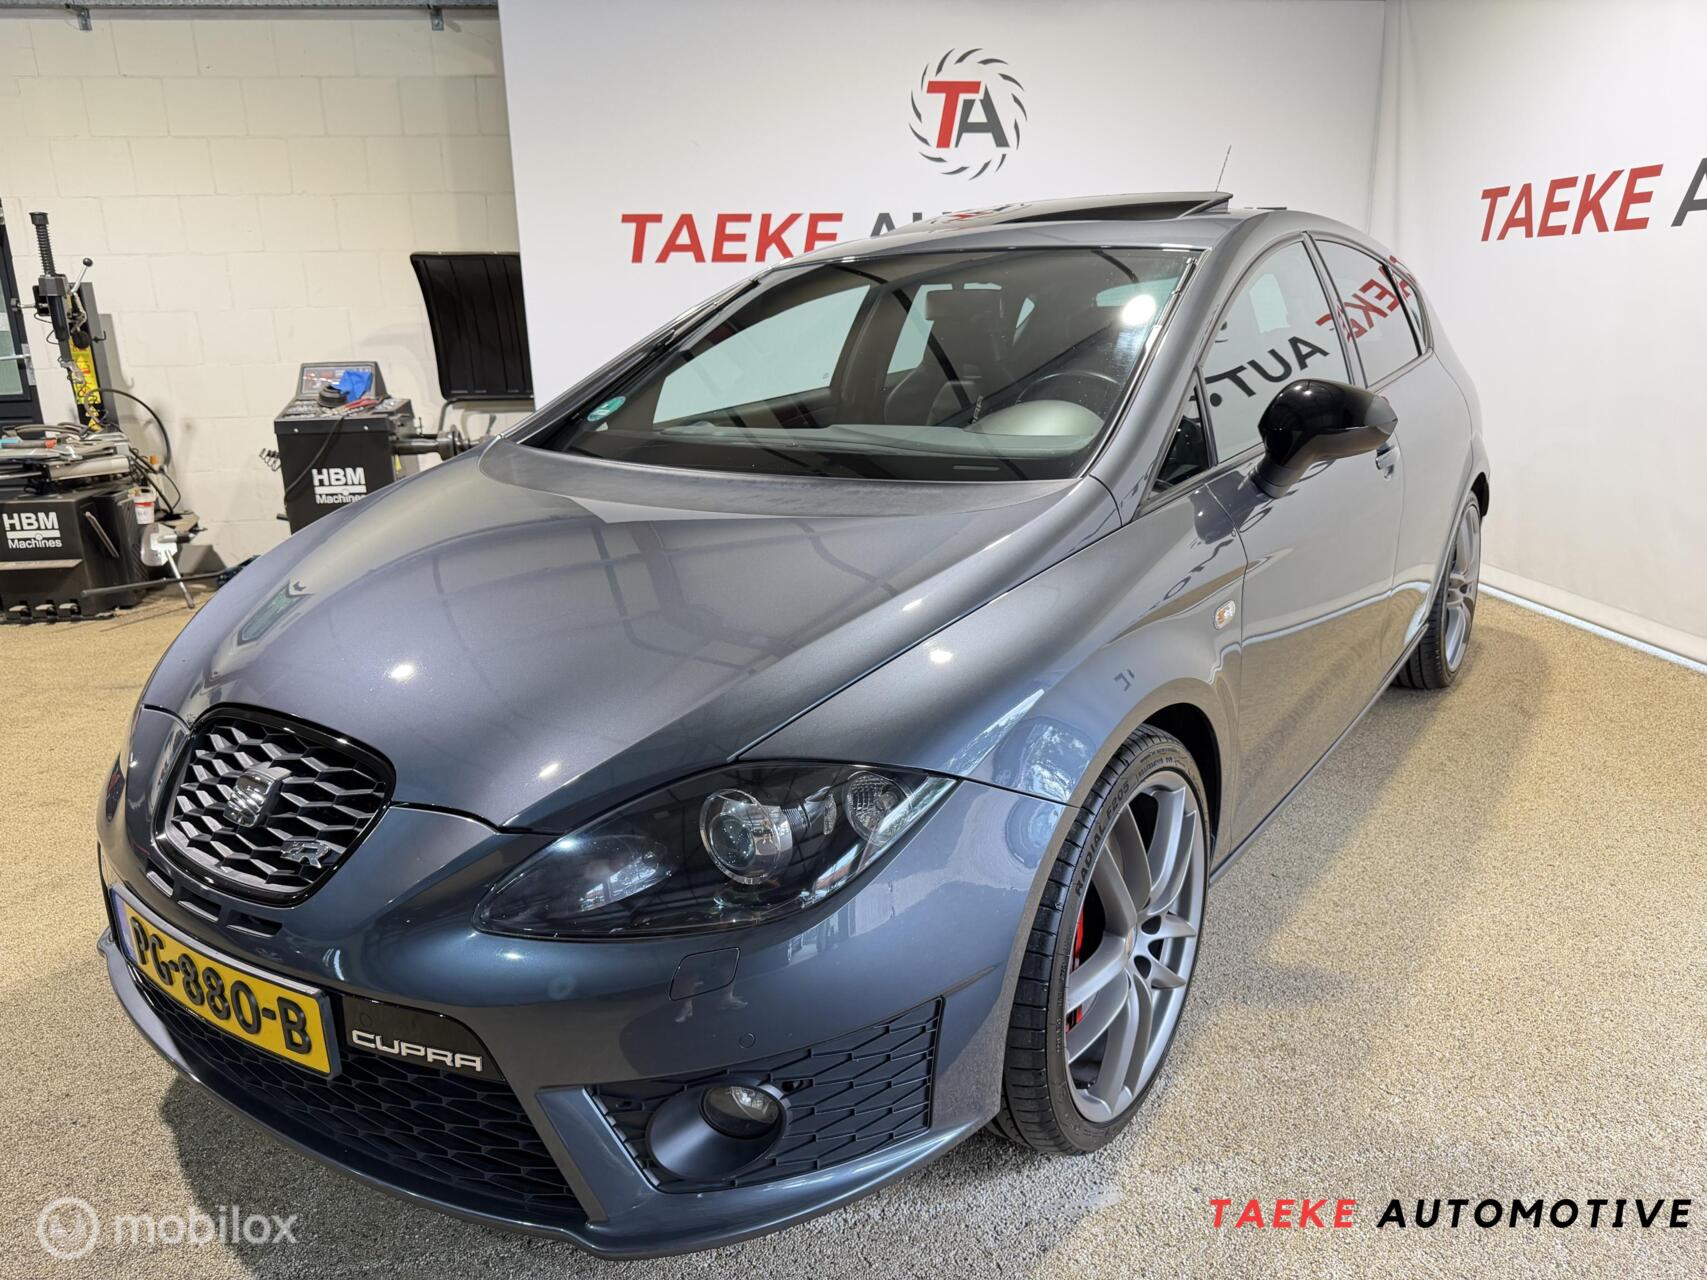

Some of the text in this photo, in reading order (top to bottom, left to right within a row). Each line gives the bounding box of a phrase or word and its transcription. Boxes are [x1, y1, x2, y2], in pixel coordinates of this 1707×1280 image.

[927, 81, 1010, 148] TA
[1481, 164, 1664, 241] TAEKE
[621, 212, 844, 264] TAEKE
[312, 467, 366, 486] HBM
[2, 511, 59, 530] HBM
[8, 538, 62, 549] Machines
[129, 915, 312, 1055] PG-880-B
[352, 1029, 483, 1072] CUPRA
